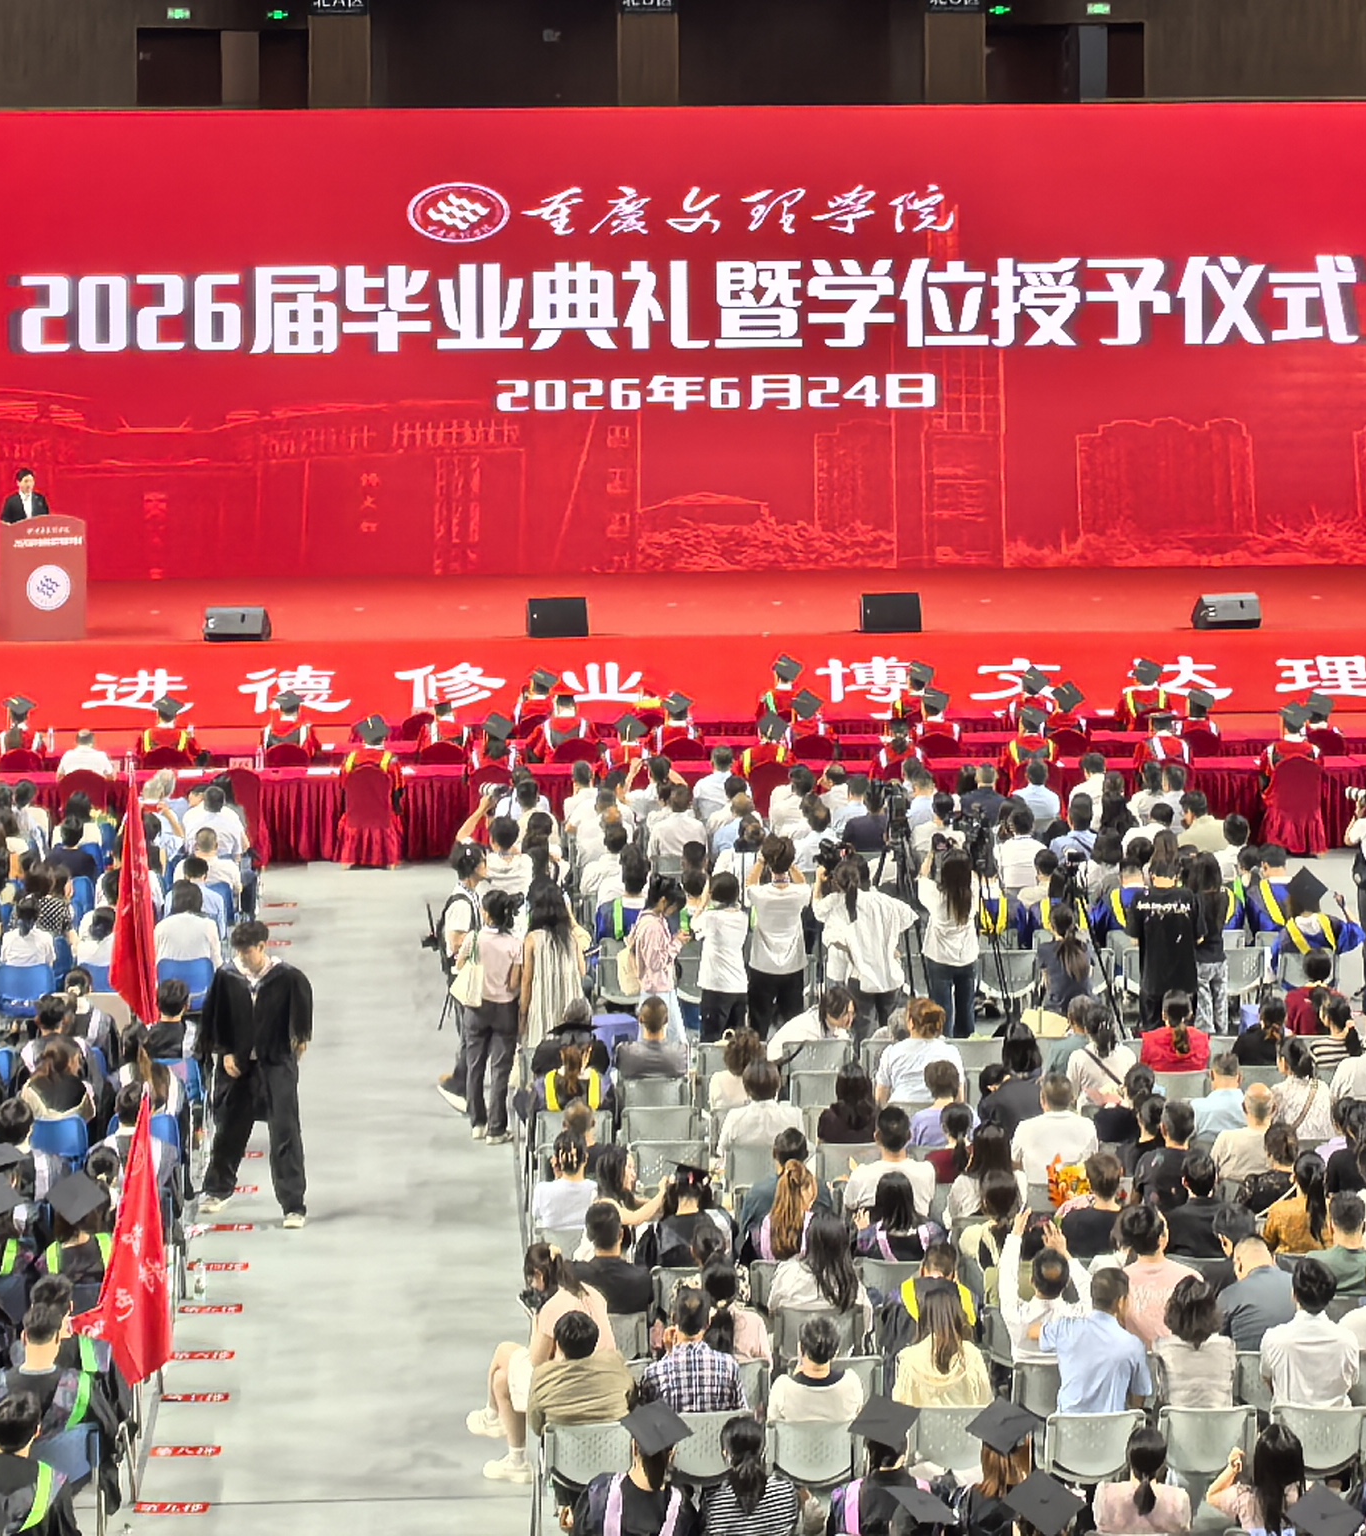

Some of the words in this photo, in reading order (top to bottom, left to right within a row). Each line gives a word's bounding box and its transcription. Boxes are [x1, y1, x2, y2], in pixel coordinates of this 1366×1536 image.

[15, 254, 1360, 355] 2026届毕业典礼暨学位授予仪式
[495, 373, 937, 412] 2026年6月24日
